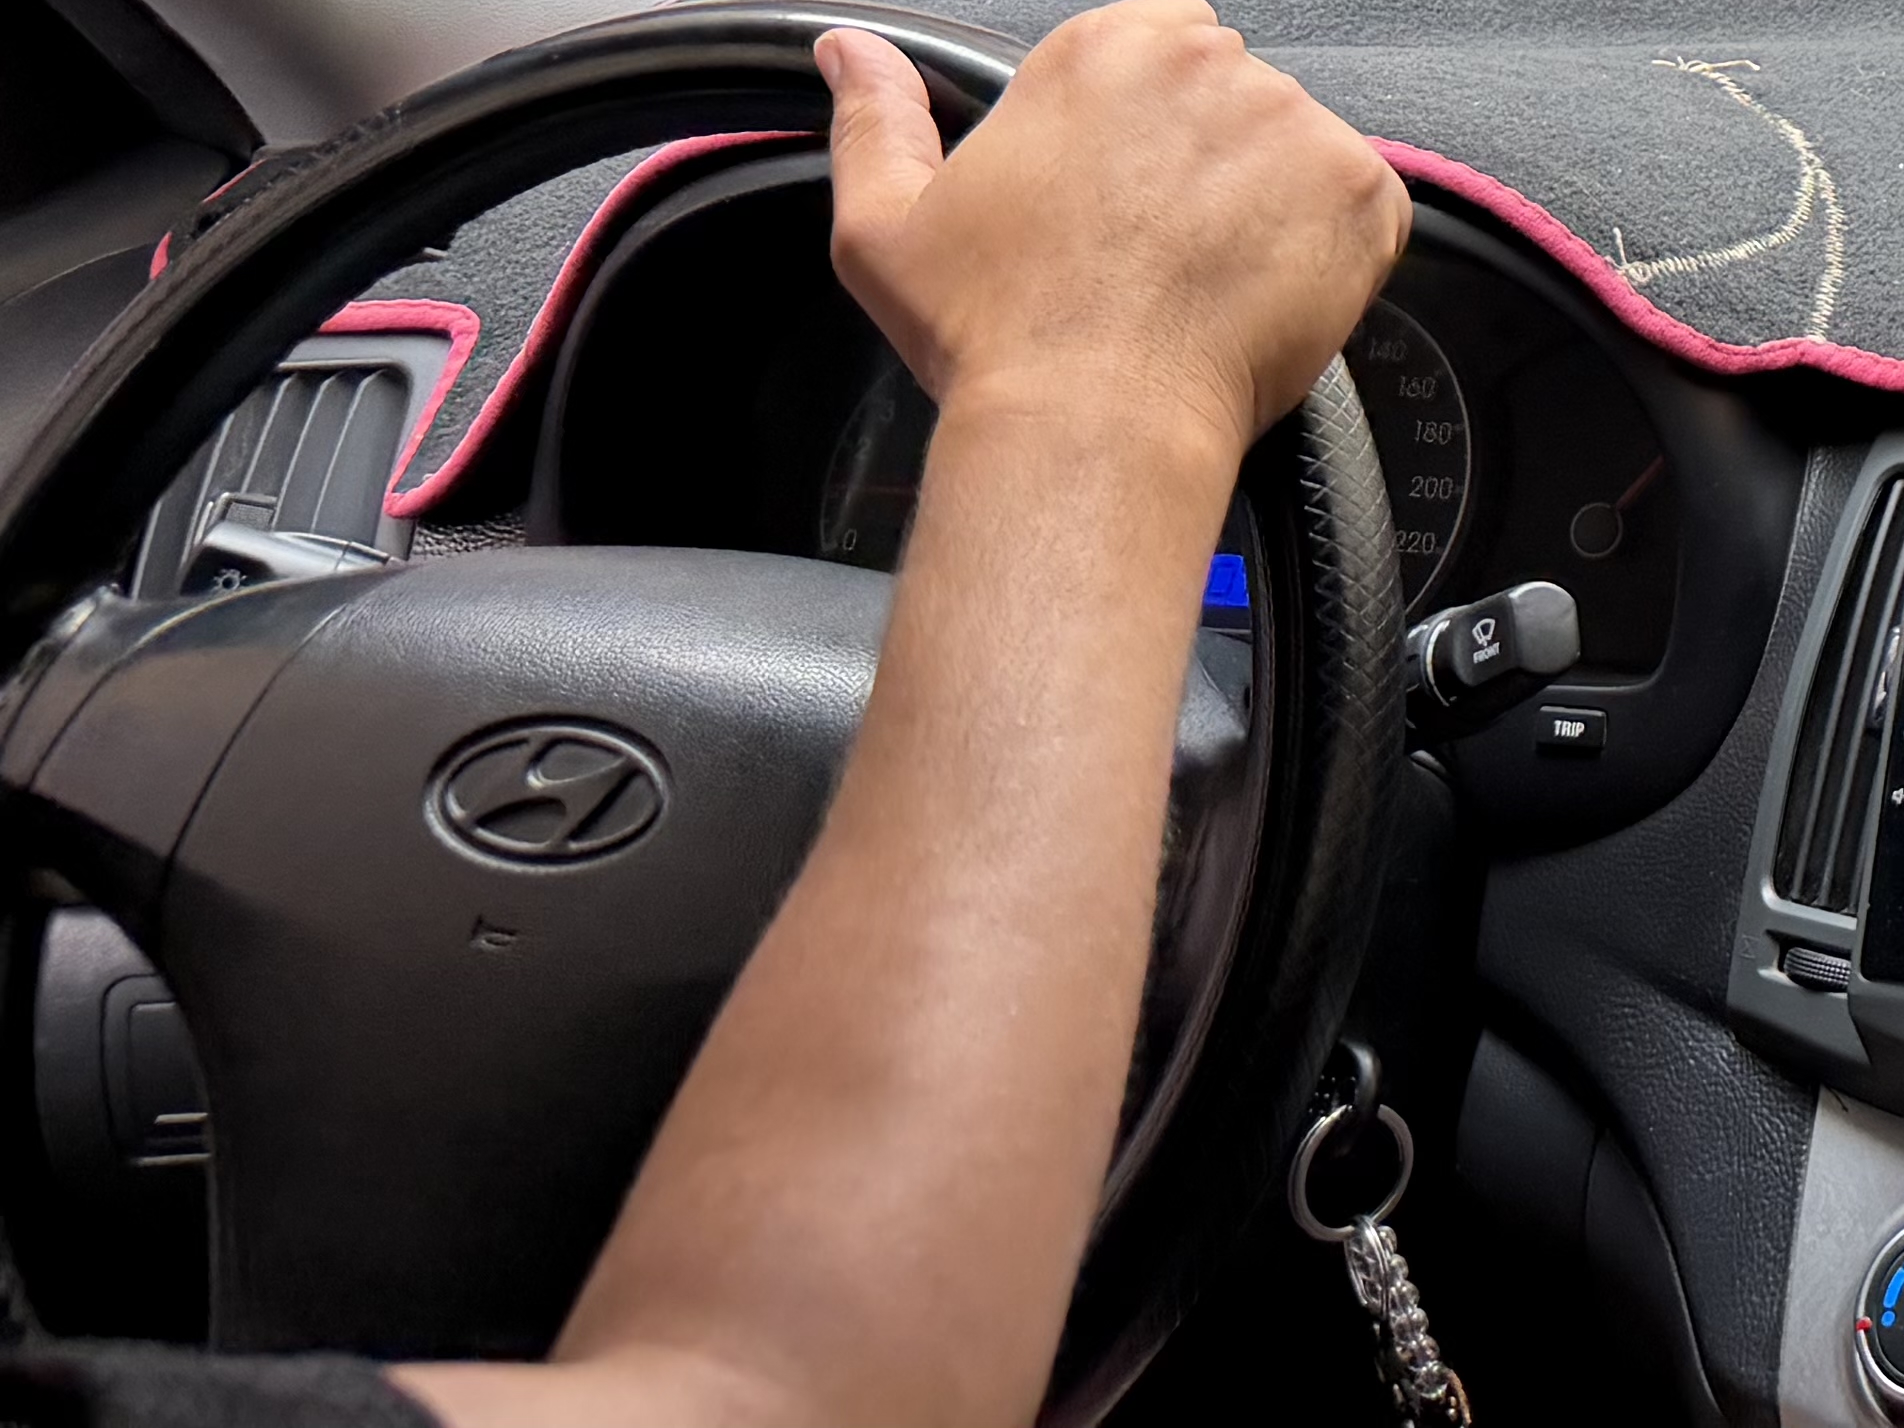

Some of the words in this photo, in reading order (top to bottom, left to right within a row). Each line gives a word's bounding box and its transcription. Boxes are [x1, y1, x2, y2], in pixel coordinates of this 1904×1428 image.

[1414, 419, 1453, 445] 180
[1408, 475, 1454, 500] 200
[1395, 529, 1437, 554] 220
[1472, 641, 1501, 664] FRONT
[1553, 719, 1586, 738] TRIP
